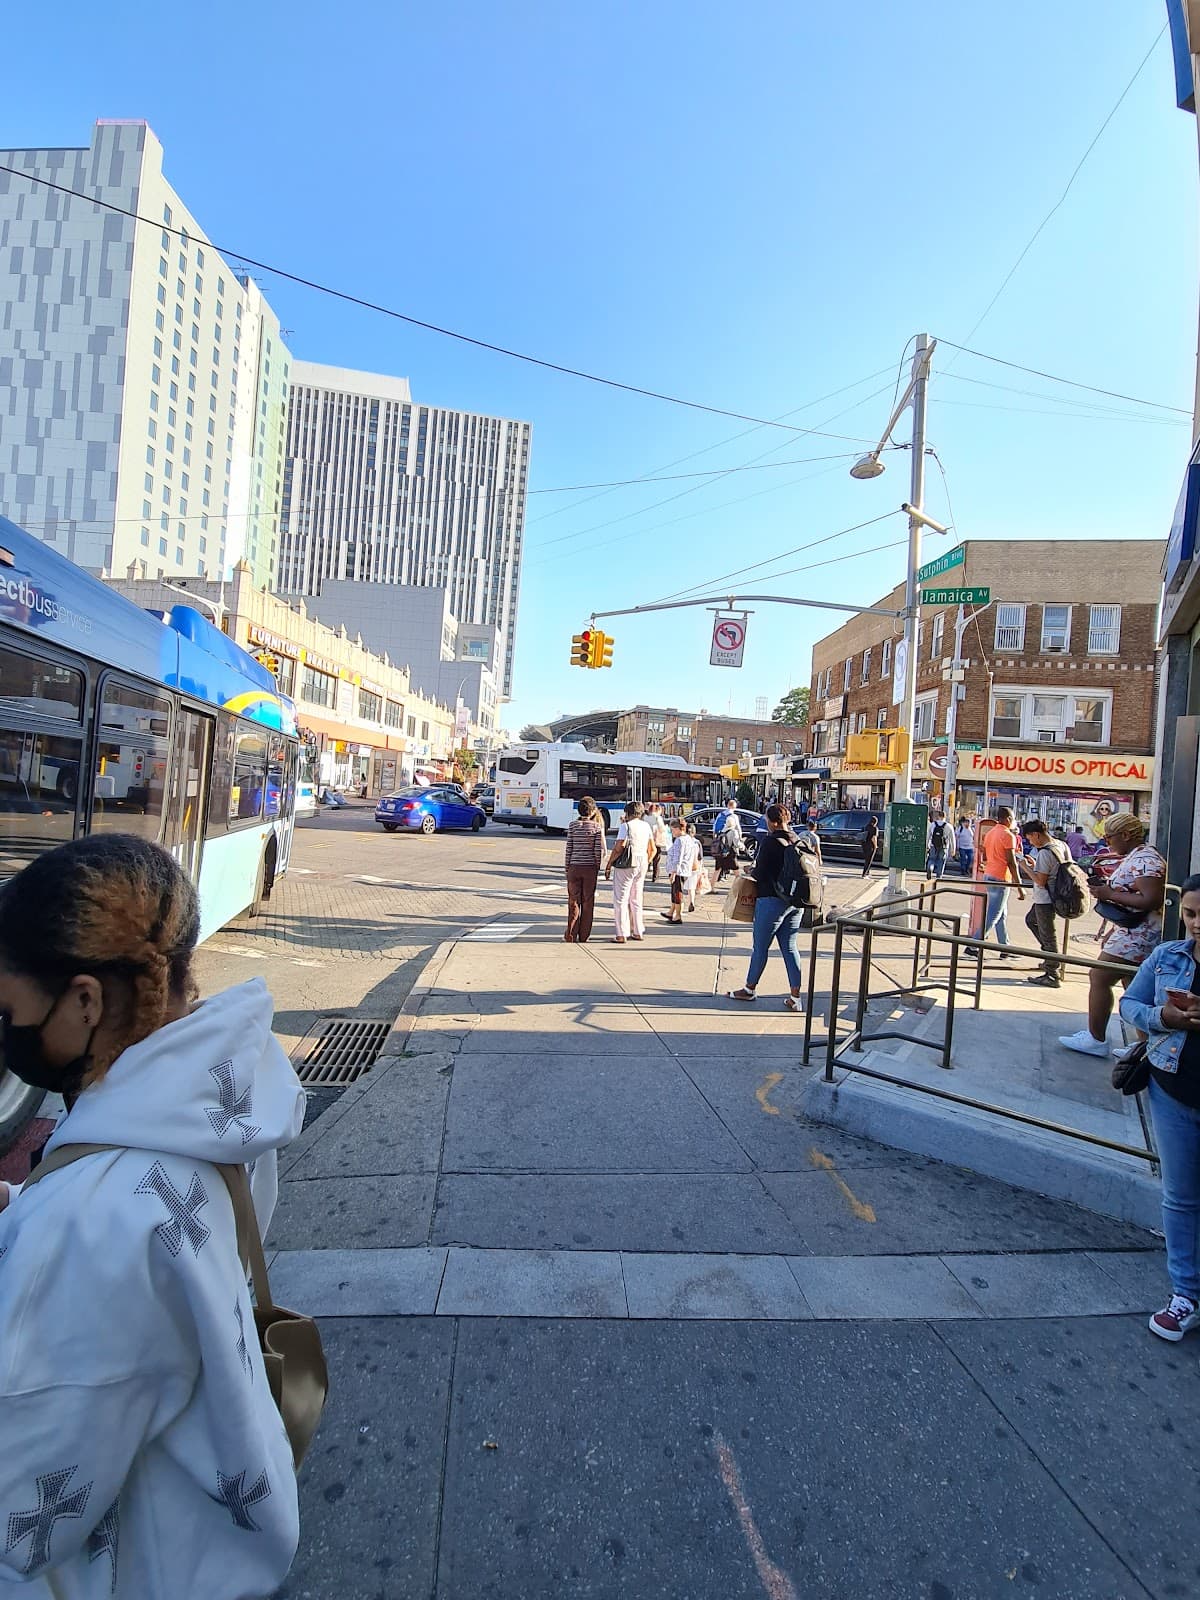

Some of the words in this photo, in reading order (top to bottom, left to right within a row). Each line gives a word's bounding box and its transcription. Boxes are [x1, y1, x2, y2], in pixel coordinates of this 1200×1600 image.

[920, 558, 949, 580] Sutphin
[951, 549, 963, 561] Blvd
[923, 588, 973, 602] Jamaica
[251, 625, 301, 659] FURNITURE
[972, 754, 1066, 774] FABULOUS
[1071, 759, 1147, 779] OPTICAL
